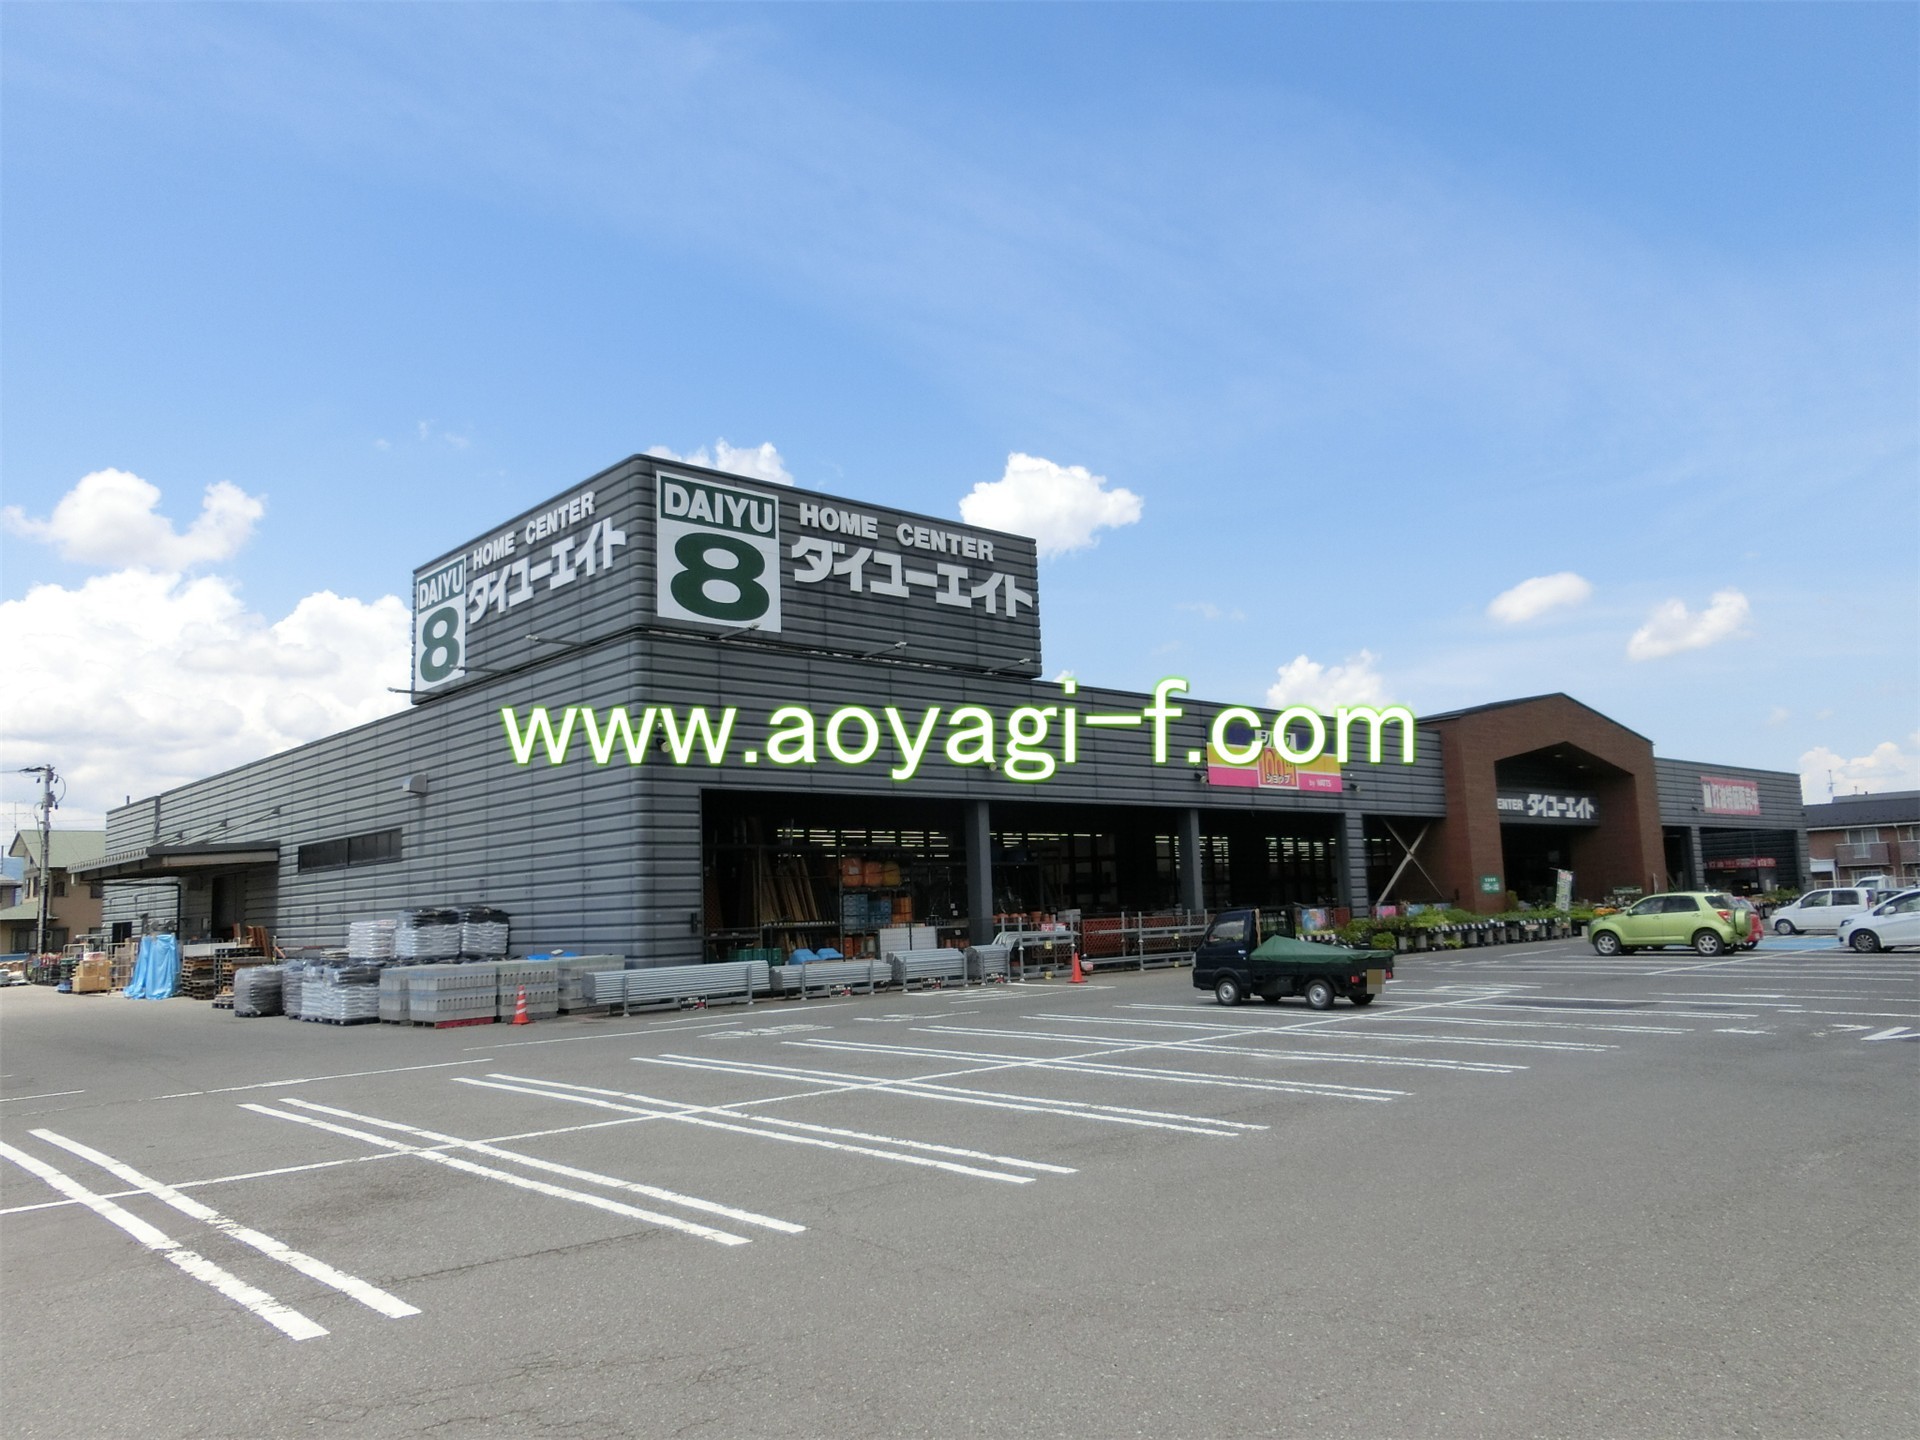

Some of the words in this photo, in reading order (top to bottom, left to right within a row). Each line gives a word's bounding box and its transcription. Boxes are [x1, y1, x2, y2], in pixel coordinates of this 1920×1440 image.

[473, 531, 515, 571] HOME
[525, 491, 595, 545] CENTER
[664, 482, 773, 533] DAIYU
[800, 503, 878, 540] HOME
[896, 522, 994, 562] CENTER
[418, 563, 464, 611] DAIYU
[468, 516, 626, 625] ダイユーエイト
[670, 532, 770, 622] 8
[791, 535, 1033, 618] ダイユーエイト
[419, 606, 460, 683] 8
[1496, 798, 1524, 811] ENTER
[1527, 793, 1595, 819] ダイユーエイト
